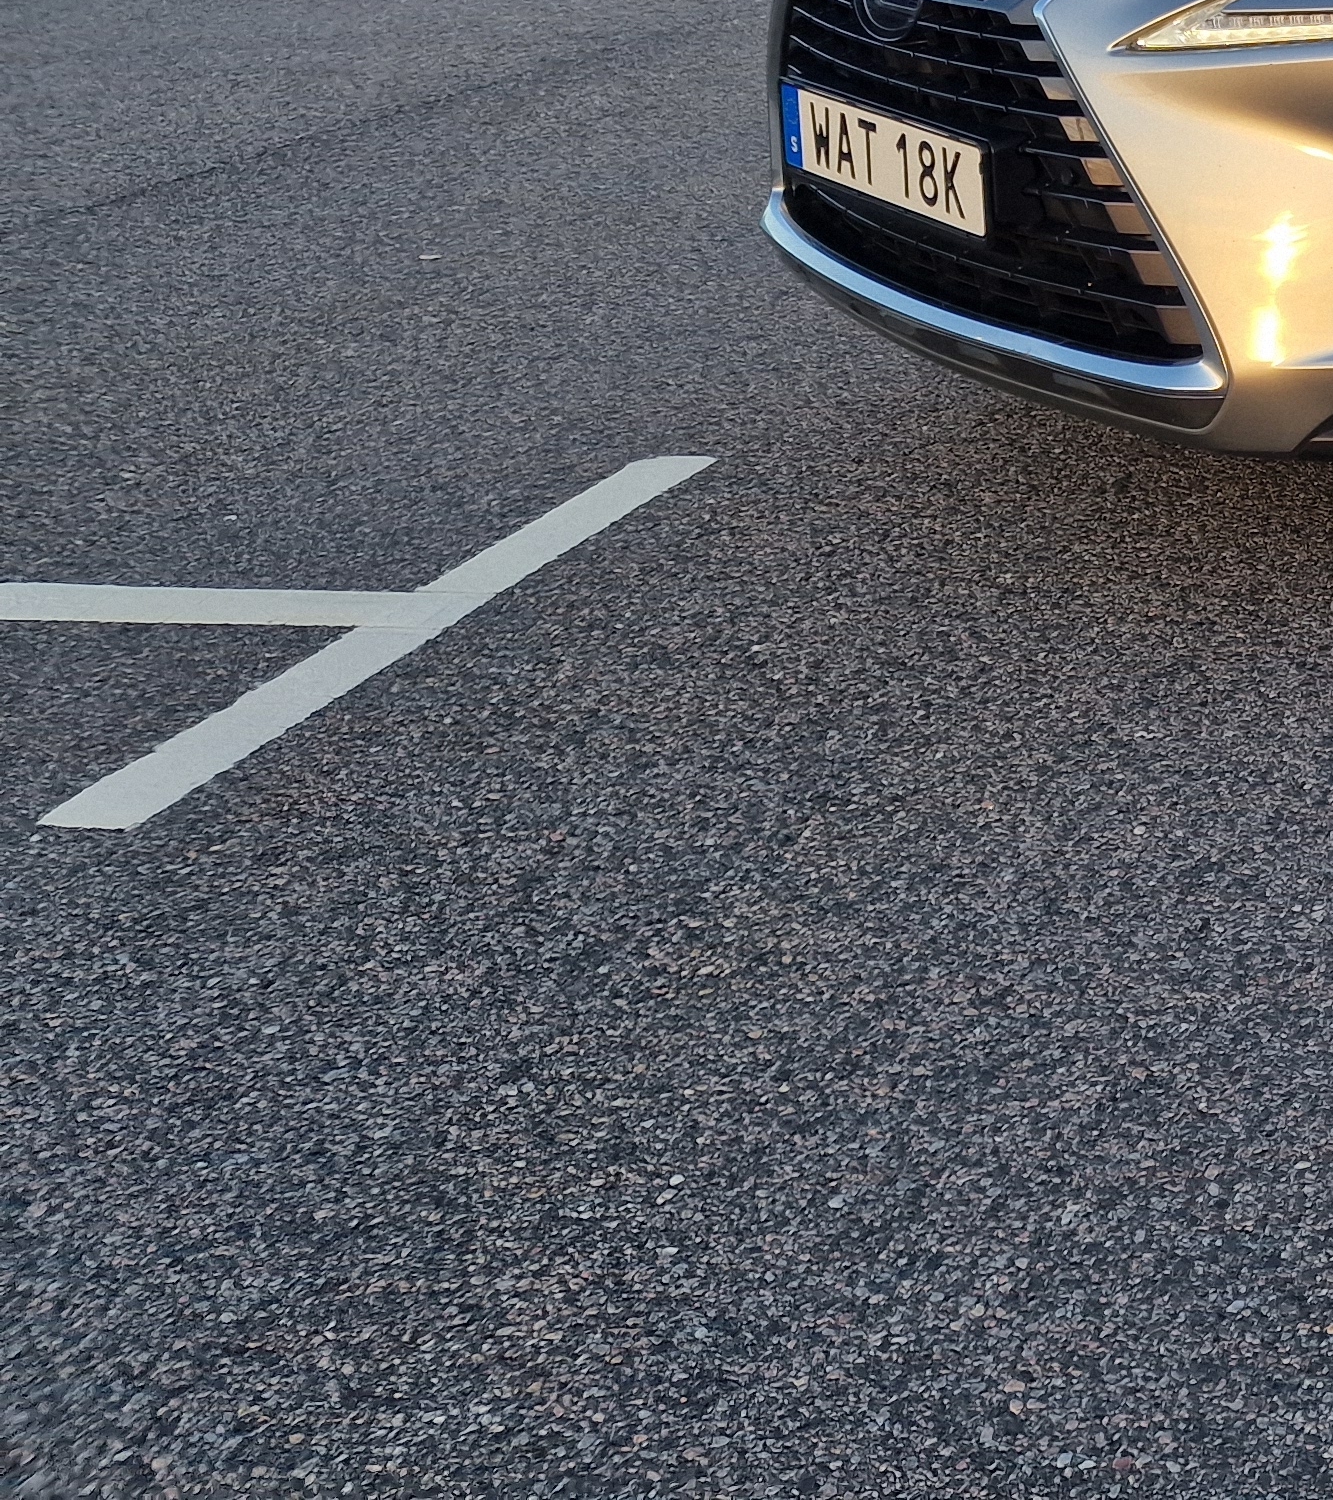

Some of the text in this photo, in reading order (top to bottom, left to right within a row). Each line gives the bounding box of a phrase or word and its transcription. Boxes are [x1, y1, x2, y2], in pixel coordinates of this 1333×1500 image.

[790, 135, 799, 153] S
[809, 101, 966, 219] WAT 18K
